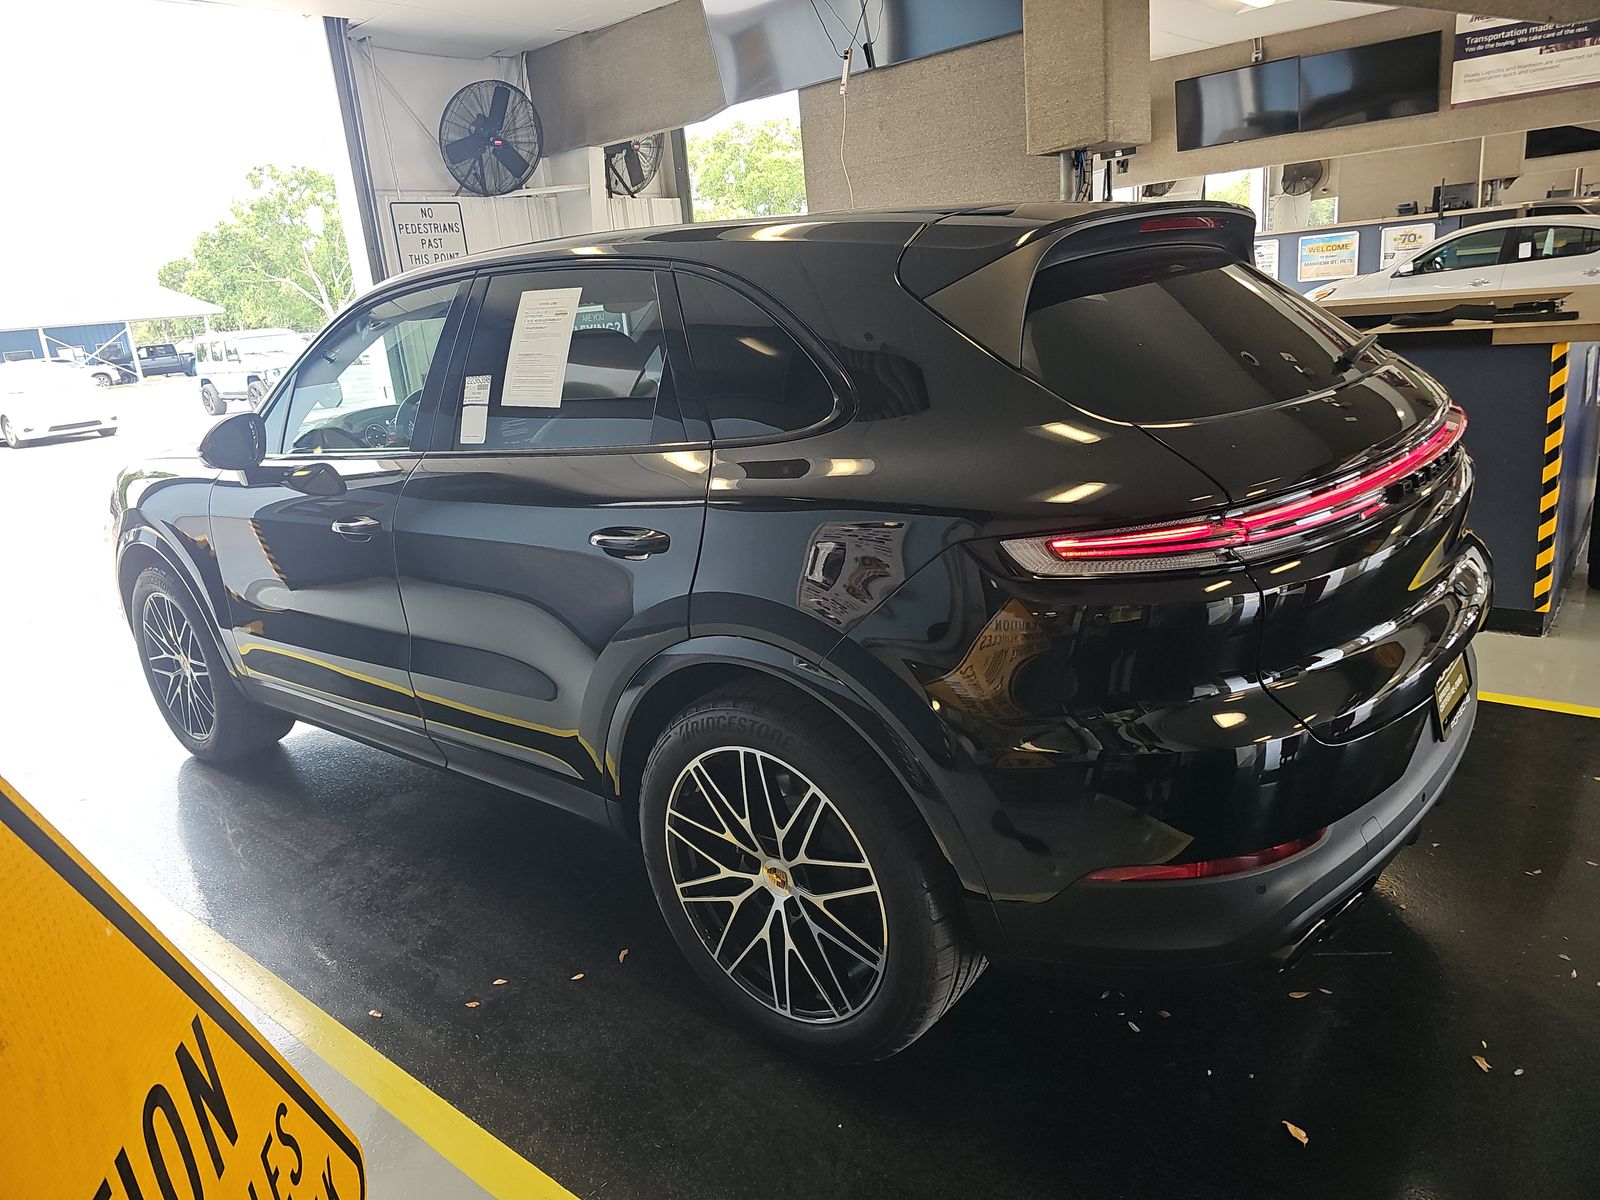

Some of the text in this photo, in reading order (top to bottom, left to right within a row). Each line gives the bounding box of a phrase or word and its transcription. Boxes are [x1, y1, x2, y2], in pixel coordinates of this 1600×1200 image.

[1465, 28, 1527, 45] Transportation
[1529, 23, 1554, 37] made
[1495, 39, 1516, 48] buying.
[1518, 36, 1528, 44] We
[1575, 25, 1590, 33] rest.
[420, 207, 434, 219] NO
[398, 222, 460, 235] PEDESTRIANS
[420, 238, 443, 249] PAST
[1308, 243, 1351, 253] WELCOME
[408, 252, 460, 265] THIS POINT
[678, 715, 796, 752] BRIDGESTONE
[92, 1012, 239, 1200] ON
